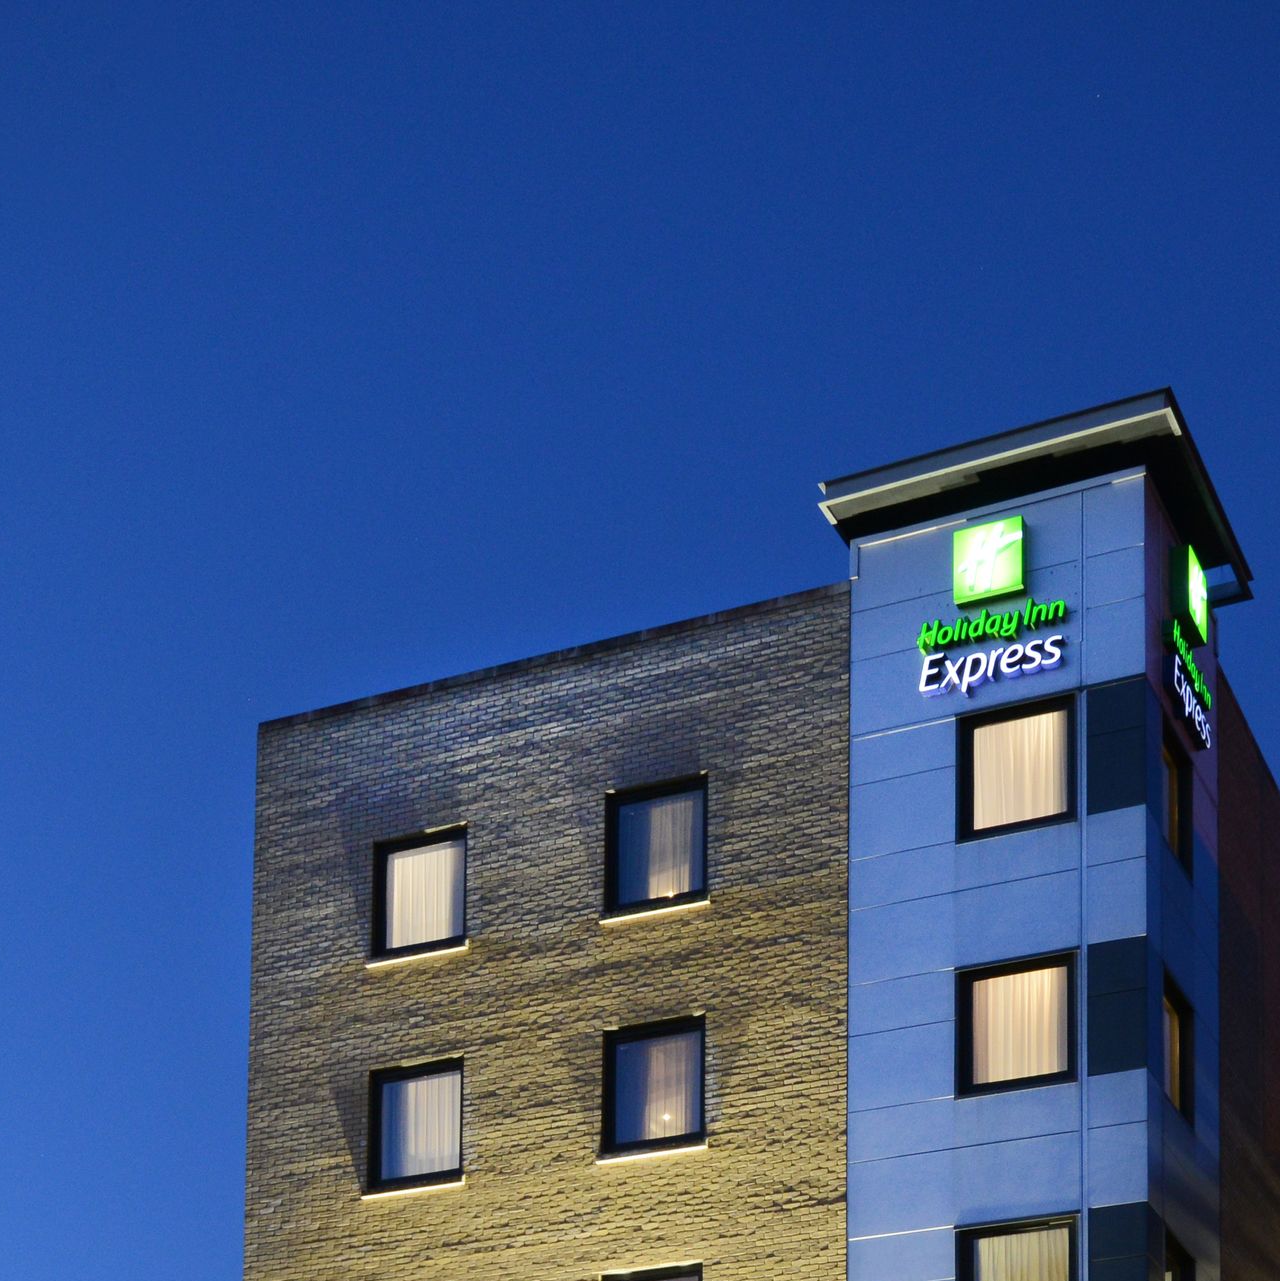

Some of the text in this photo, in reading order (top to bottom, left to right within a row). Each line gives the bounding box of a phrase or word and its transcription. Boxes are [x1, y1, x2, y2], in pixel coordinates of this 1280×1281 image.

[917, 598, 1066, 651] Holiday Inn
[919, 635, 1064, 694] Express
[1173, 619, 1212, 711] Holiday Inn
[1174, 654, 1212, 749] Express
